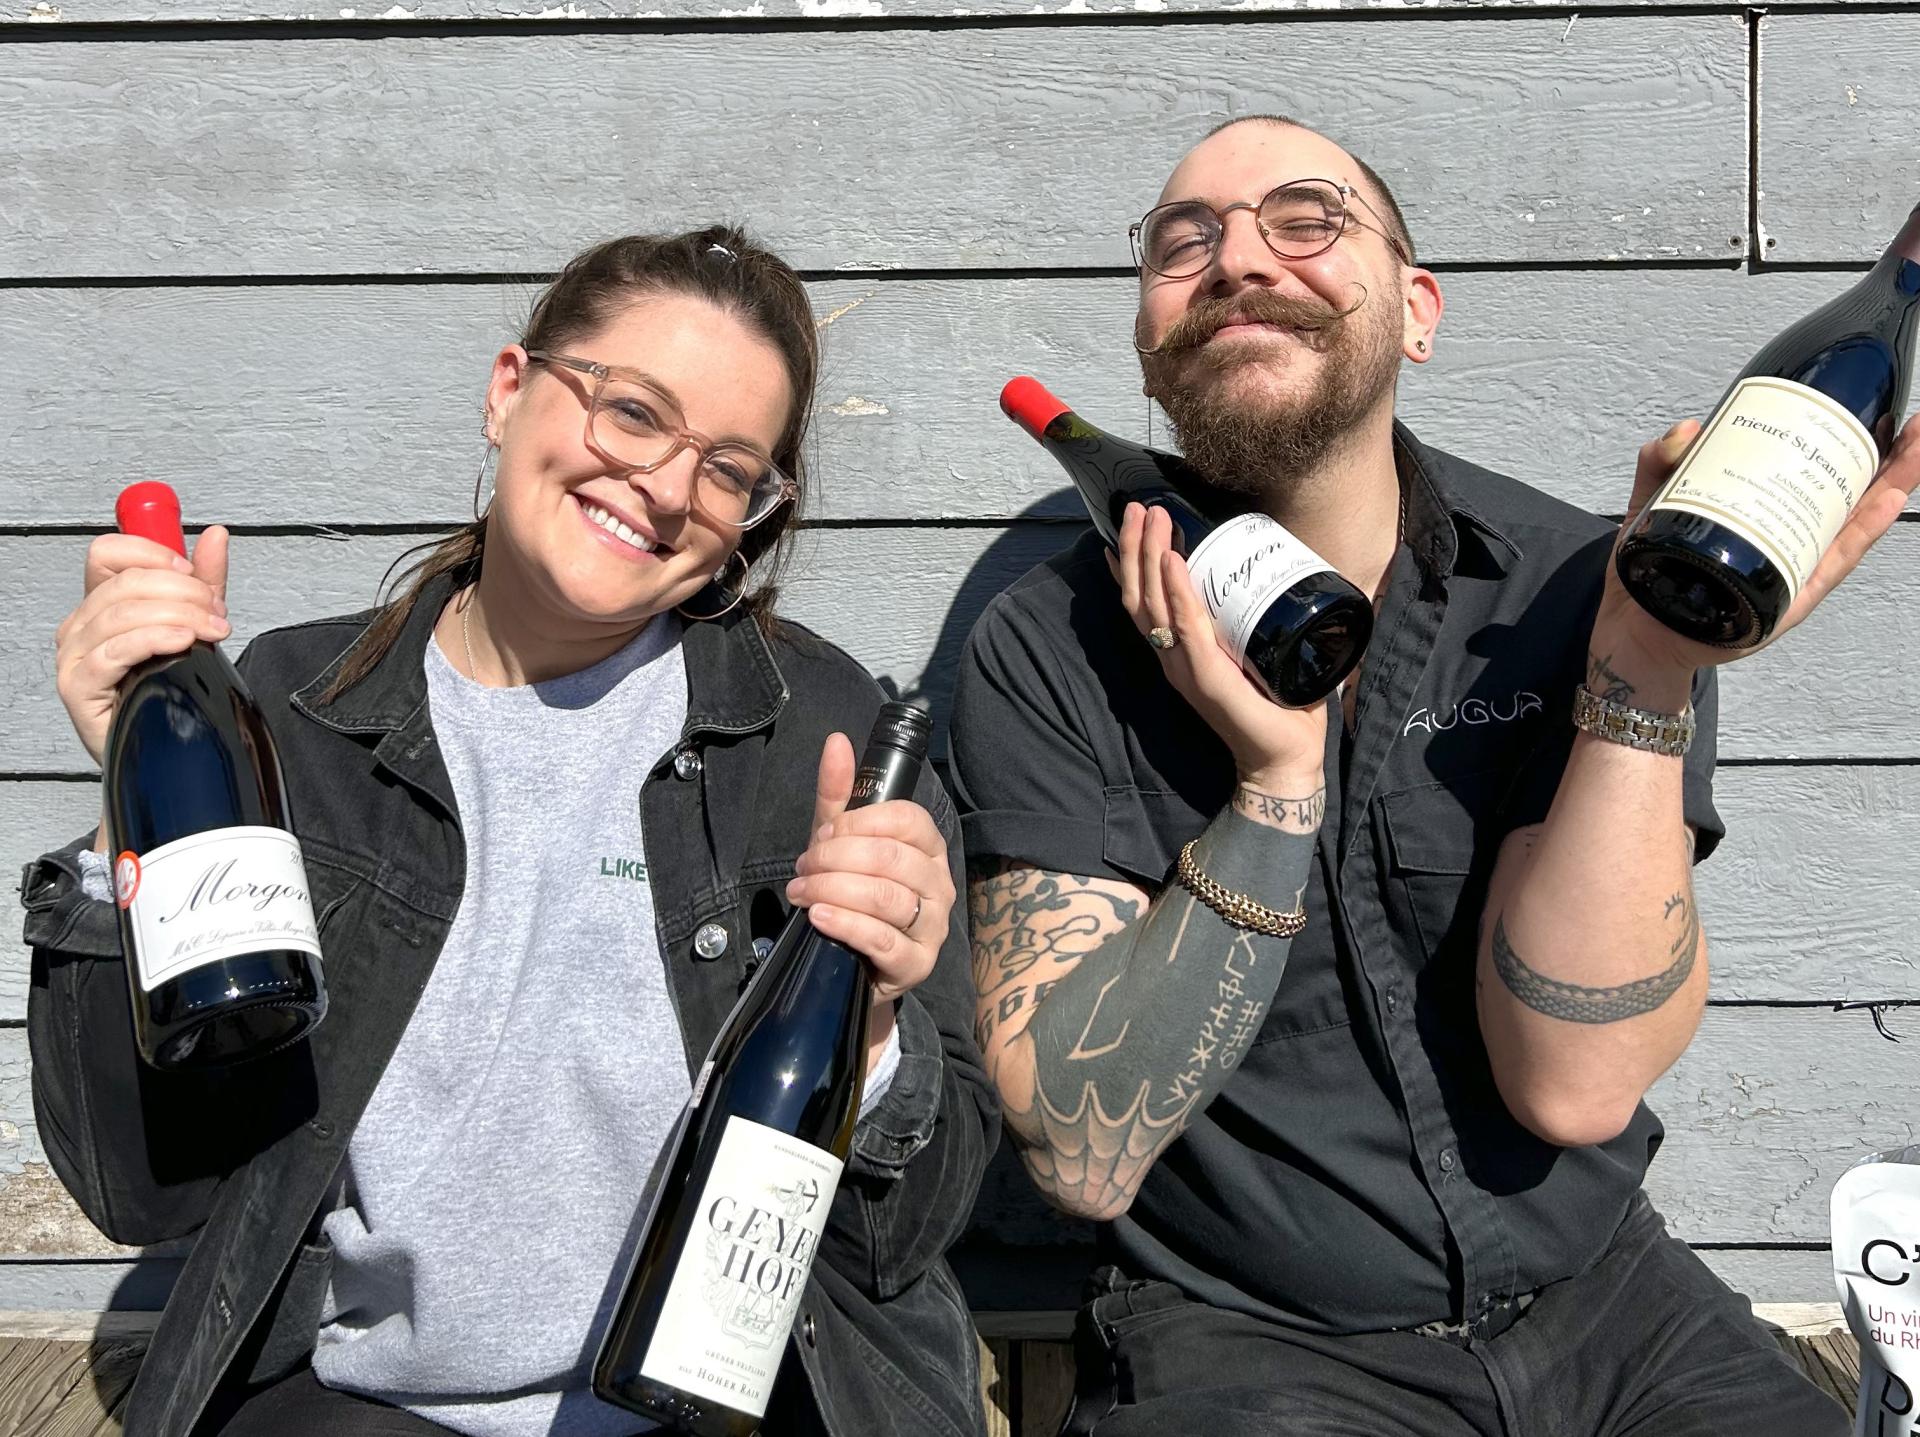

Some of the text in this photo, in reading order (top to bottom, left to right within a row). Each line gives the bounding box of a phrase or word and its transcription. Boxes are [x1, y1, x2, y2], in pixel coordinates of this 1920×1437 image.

[1731, 415, 1791, 441] Prieuré
[1837, 477, 1848, 495] de
[1775, 473, 1824, 520] LANGUEDOC
[1800, 468, 1826, 490] 2019
[1403, 690, 1543, 737] AUGUR
[600, 856, 648, 882] LIKE
[159, 858, 310, 924] Morgon
[720, 1242, 802, 1300] HOF
[1868, 1304, 1920, 1328] Un vi
[1870, 1327, 1894, 1346] du
[740, 1383, 760, 1399] RAIN
